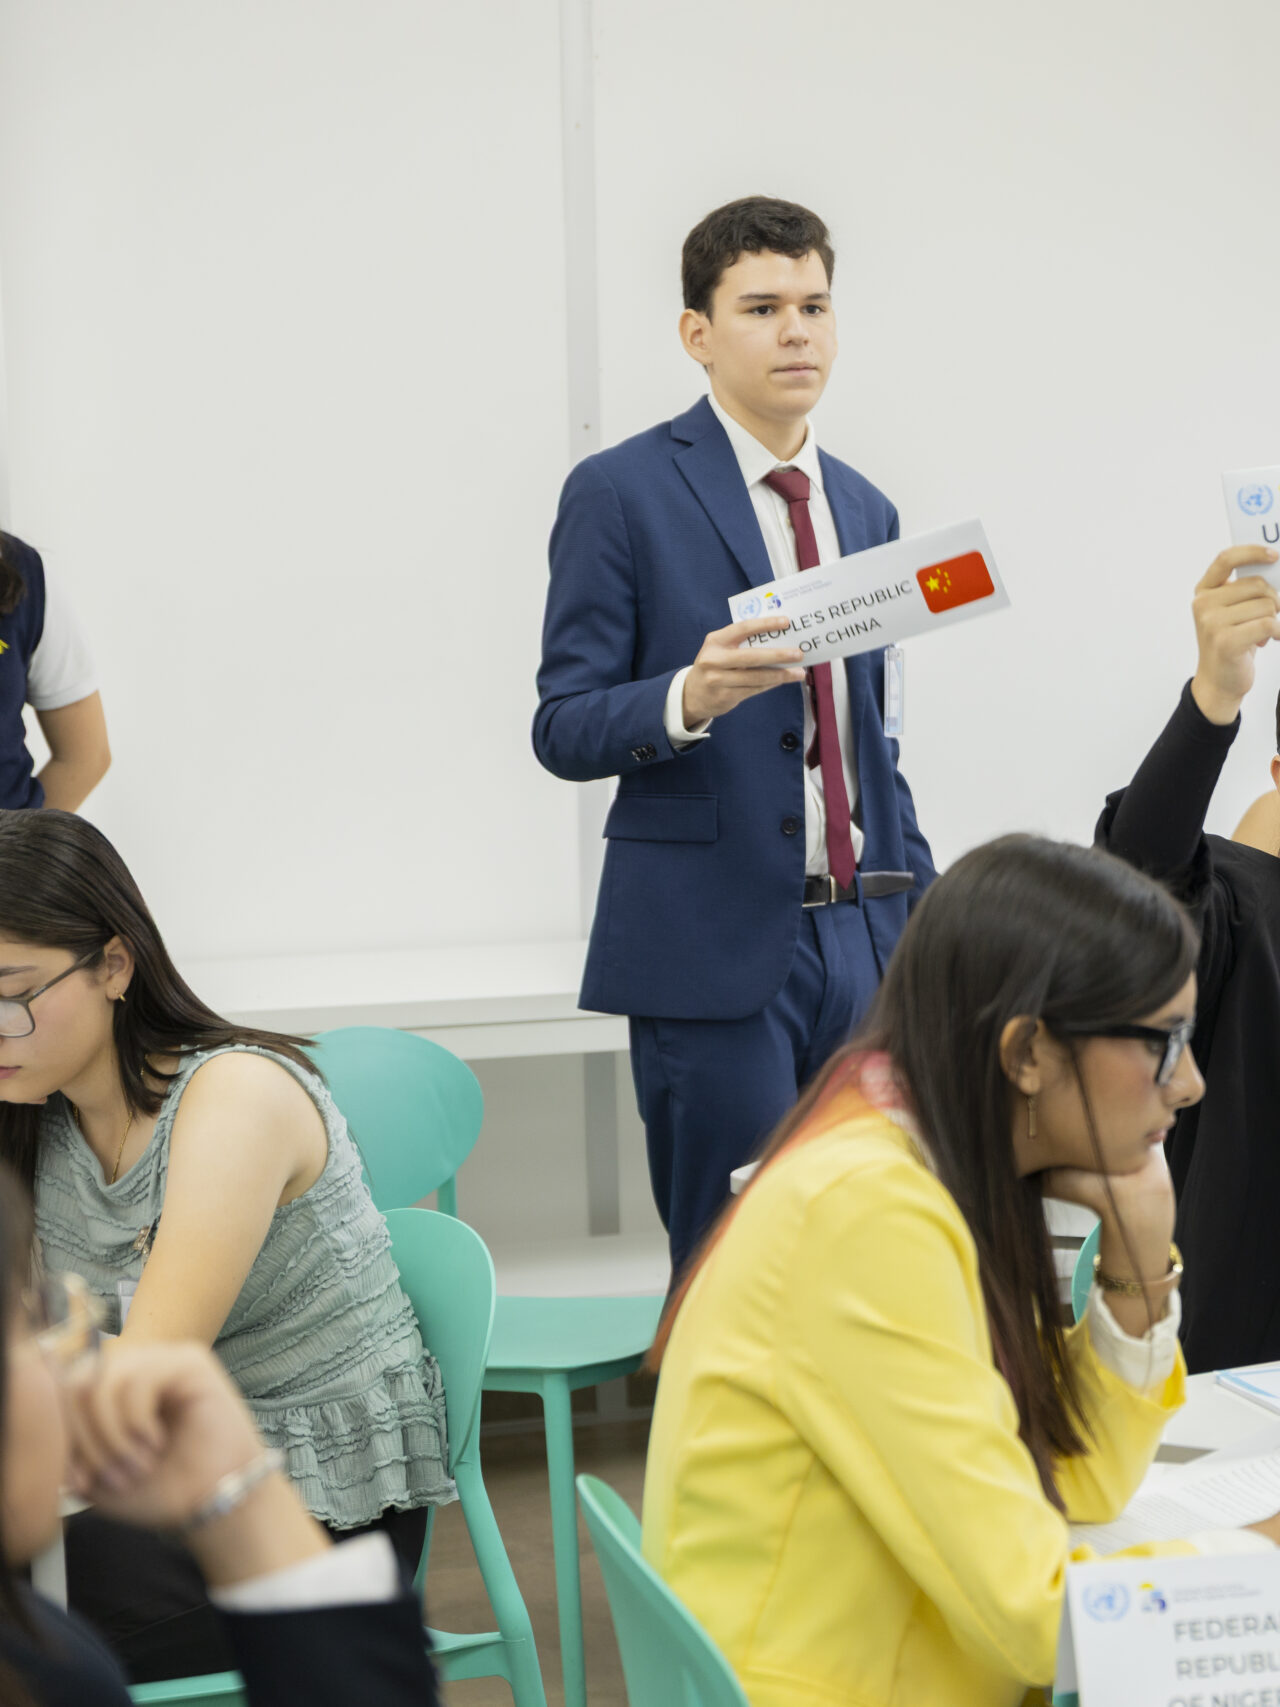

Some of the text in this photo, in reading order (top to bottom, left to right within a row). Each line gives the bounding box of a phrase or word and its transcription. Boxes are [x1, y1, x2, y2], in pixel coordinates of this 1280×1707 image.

[827, 579, 914, 620] REPUBLIC
[798, 617, 882, 653] OF CHINA
